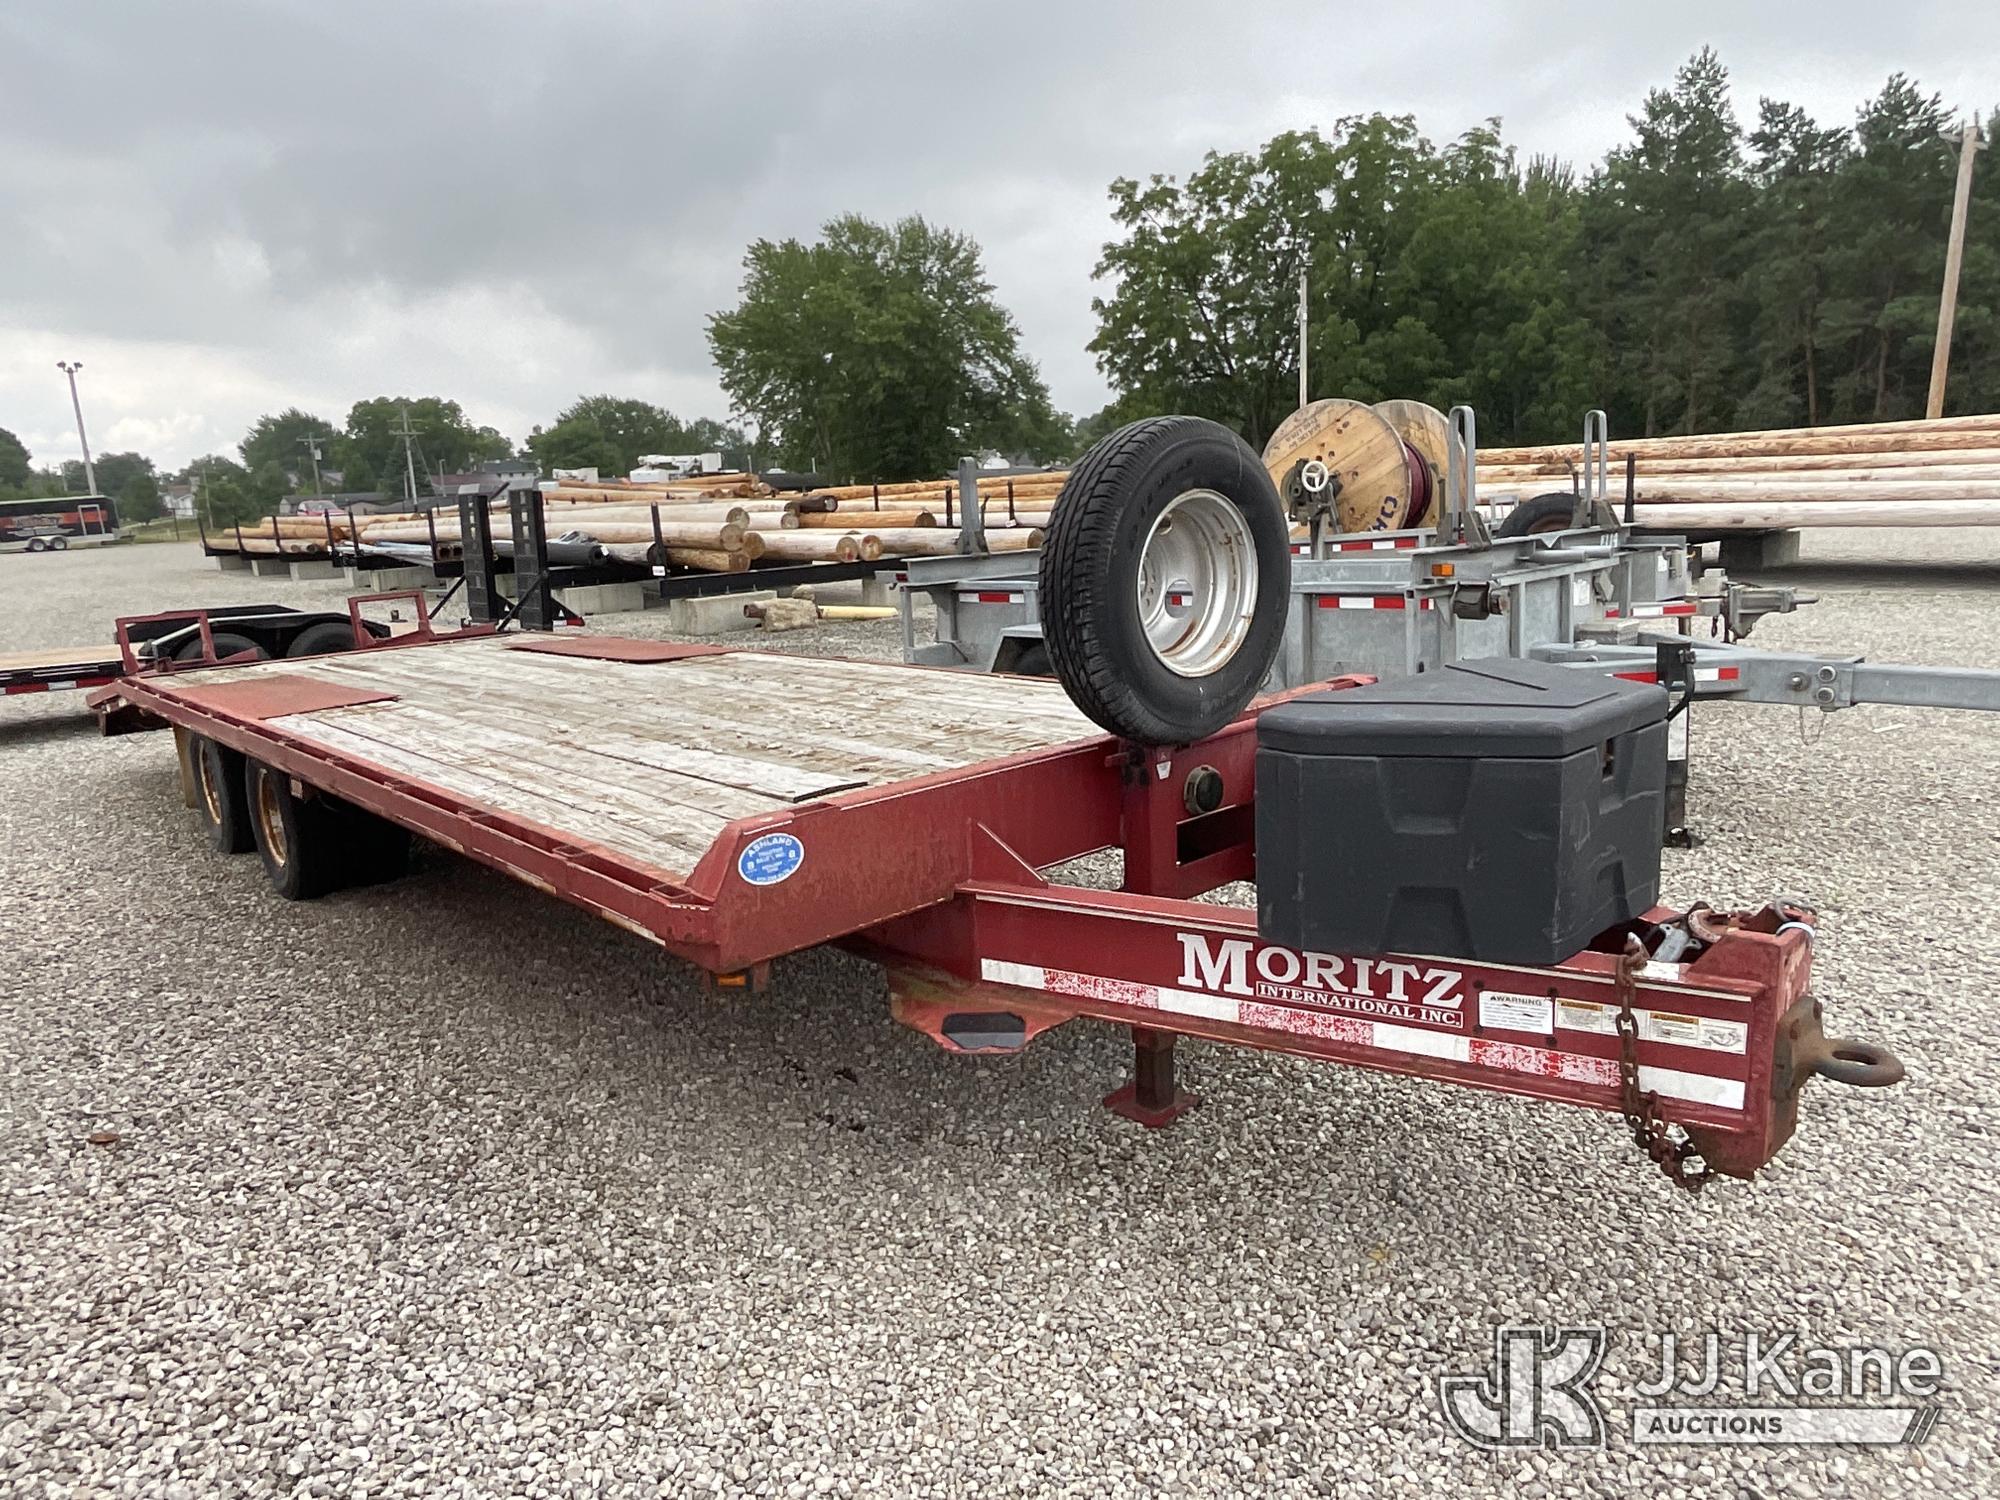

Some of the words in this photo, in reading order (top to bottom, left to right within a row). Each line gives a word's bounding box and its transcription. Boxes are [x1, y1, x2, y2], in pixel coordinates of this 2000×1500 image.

[748, 836, 793, 858] ASHLAND
[1176, 932, 1464, 1010] MORITZ
[1259, 983, 1415, 1019] INTERNATIONAL
[1419, 1009, 1461, 1027] INC.
